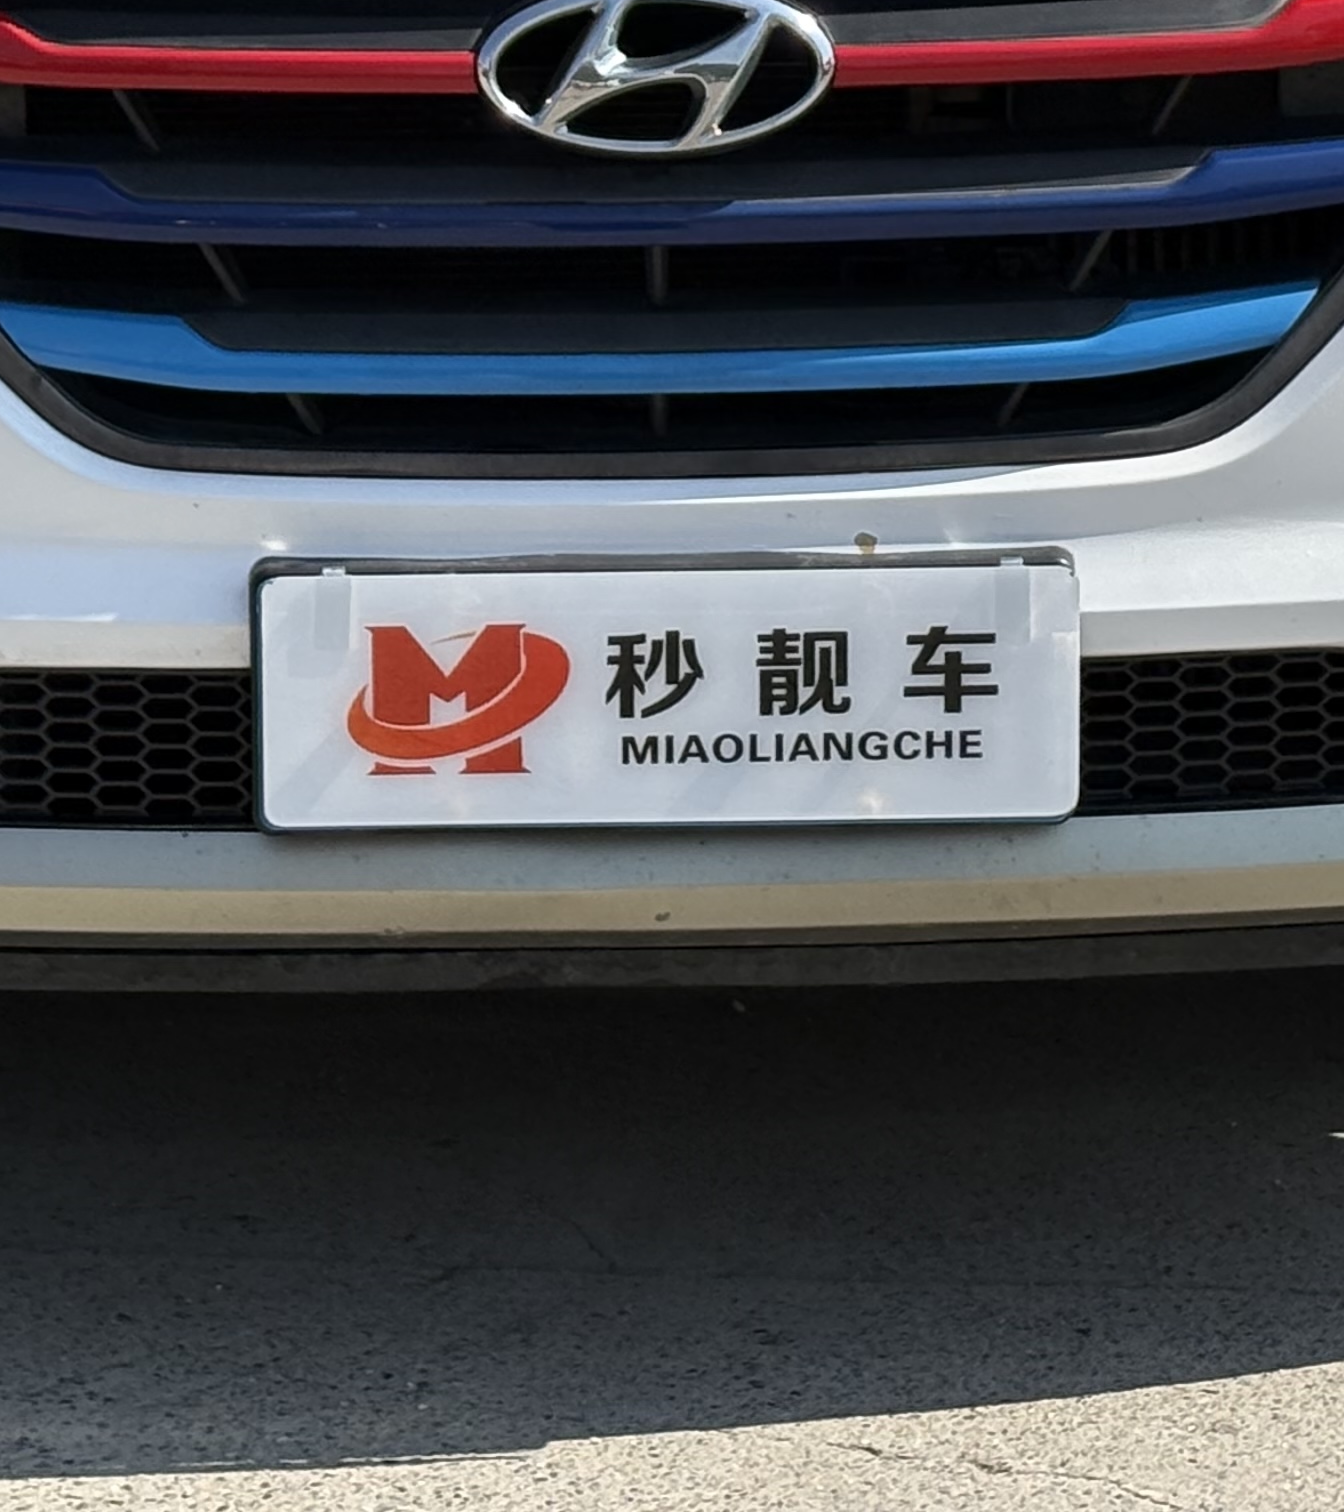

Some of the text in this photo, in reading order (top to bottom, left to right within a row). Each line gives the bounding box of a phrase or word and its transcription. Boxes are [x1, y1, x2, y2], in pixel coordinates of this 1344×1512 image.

[604, 626, 999, 719] 秒靓车
[621, 729, 983, 765] MIAOLIANGCHE
